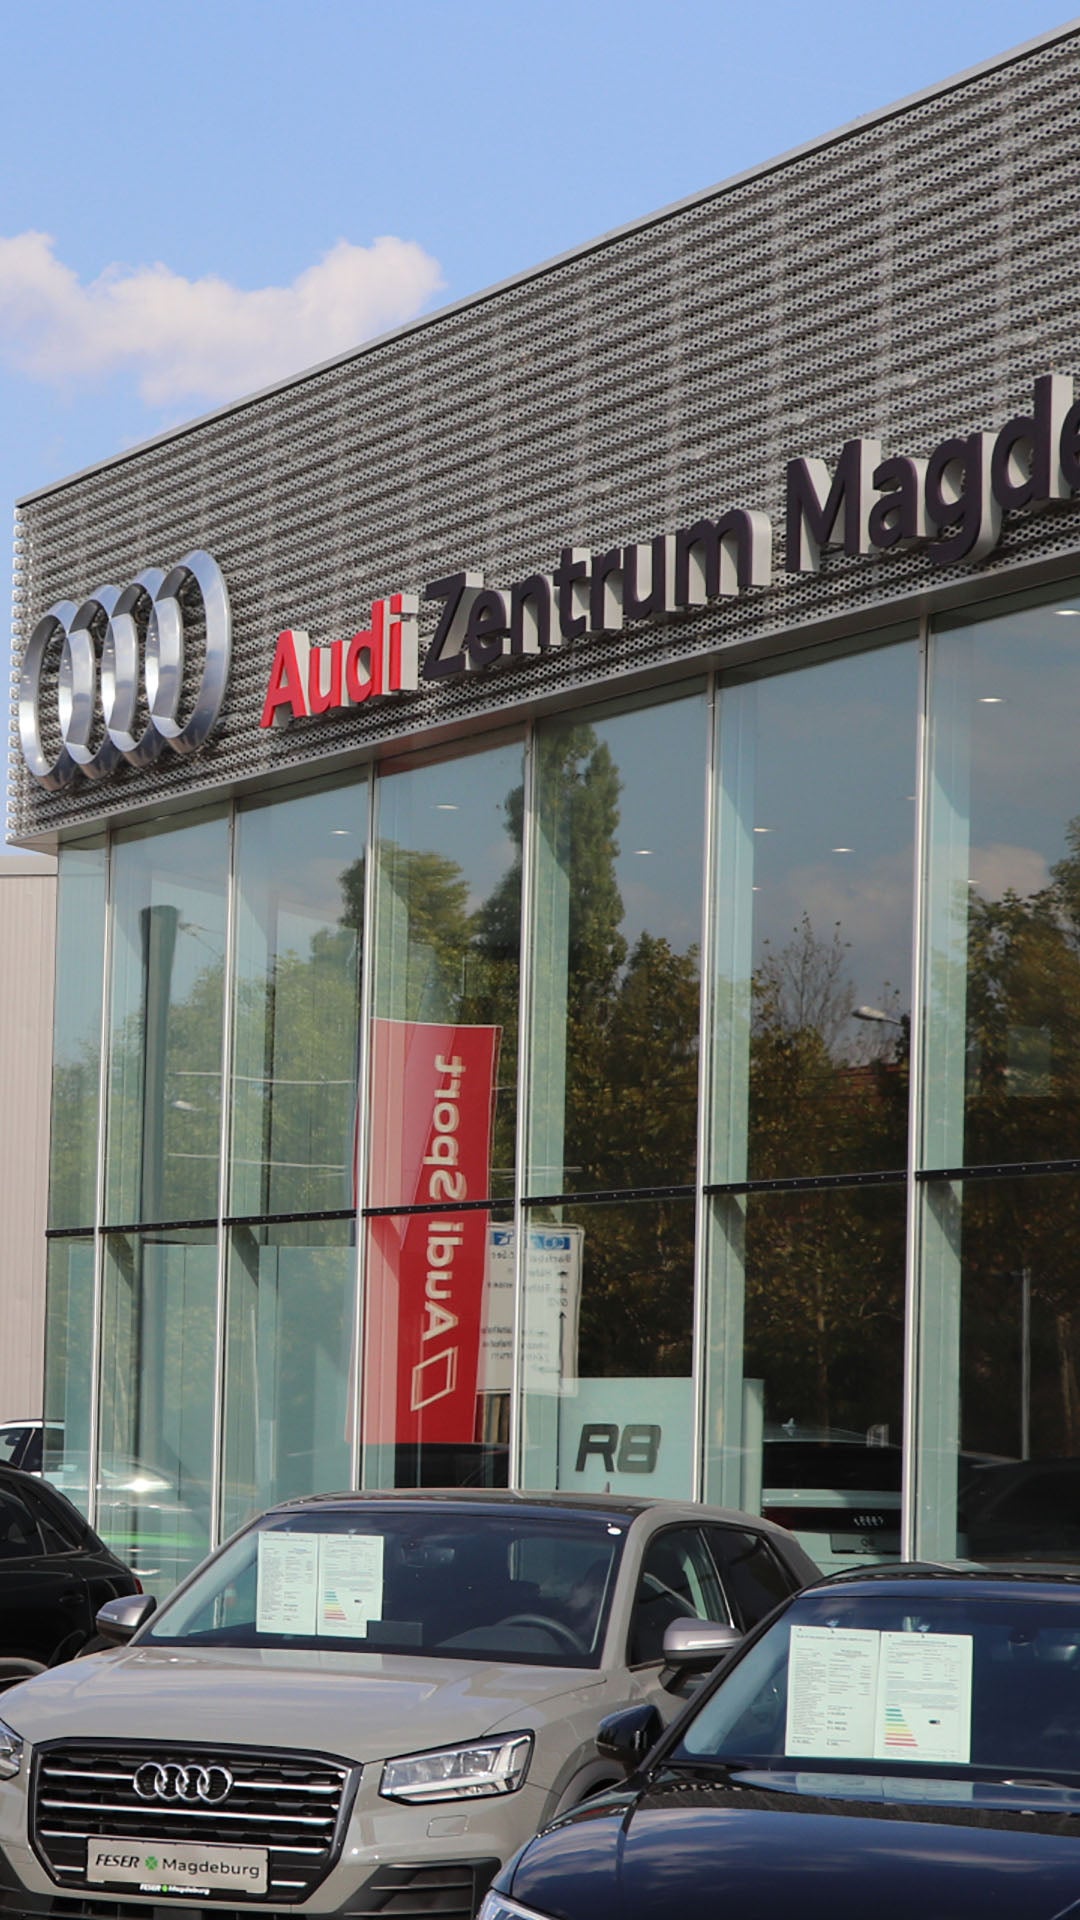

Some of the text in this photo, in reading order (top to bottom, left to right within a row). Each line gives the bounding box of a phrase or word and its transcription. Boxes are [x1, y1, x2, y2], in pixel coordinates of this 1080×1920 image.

[260, 593, 418, 727] Audi
[423, 509, 772, 681] Zentrum
[575, 1423, 662, 1474] R8
[95, 1853, 260, 1878] FESER Magdeburg
